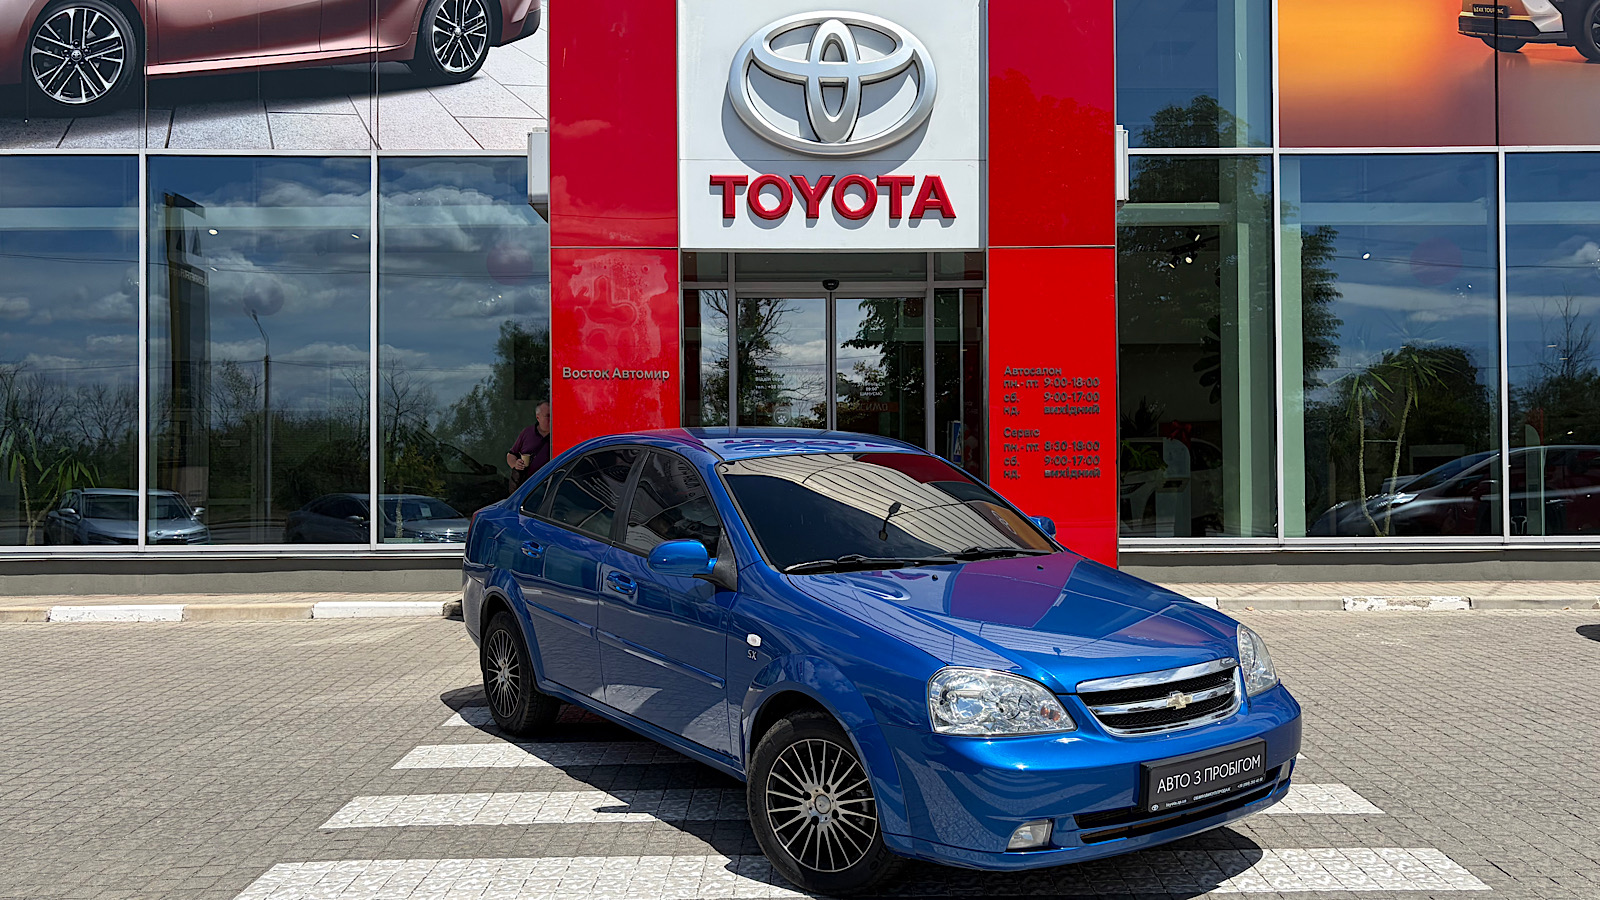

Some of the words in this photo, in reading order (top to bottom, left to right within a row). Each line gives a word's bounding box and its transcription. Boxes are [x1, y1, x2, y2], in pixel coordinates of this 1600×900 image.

[710, 174, 957, 220] TOYOTA
[562, 366, 610, 379] Восток
[612, 367, 670, 382] Автомир
[1004, 366, 1062, 376] Автосалон
[1044, 377, 1100, 388] 9:00-18:00
[1004, 392, 1020, 402] сб.
[1044, 392, 1100, 402] 9:00-17:00
[1004, 406, 1020, 416] нд.
[1044, 404, 1100, 416] вихідний
[1004, 427, 1040, 440] Сервіс
[1044, 440, 1100, 452] 8:30-18:00
[1004, 456, 1020, 466] сб.
[1044, 455, 1100, 466] 9:00-17:00
[1004, 470, 1020, 480] нд.
[1044, 466, 1101, 478] вихідний
[748, 650, 757, 660] SX
[1156, 772, 1190, 794] АВТО
[1204, 754, 1260, 782] ПРОБІГОМ
